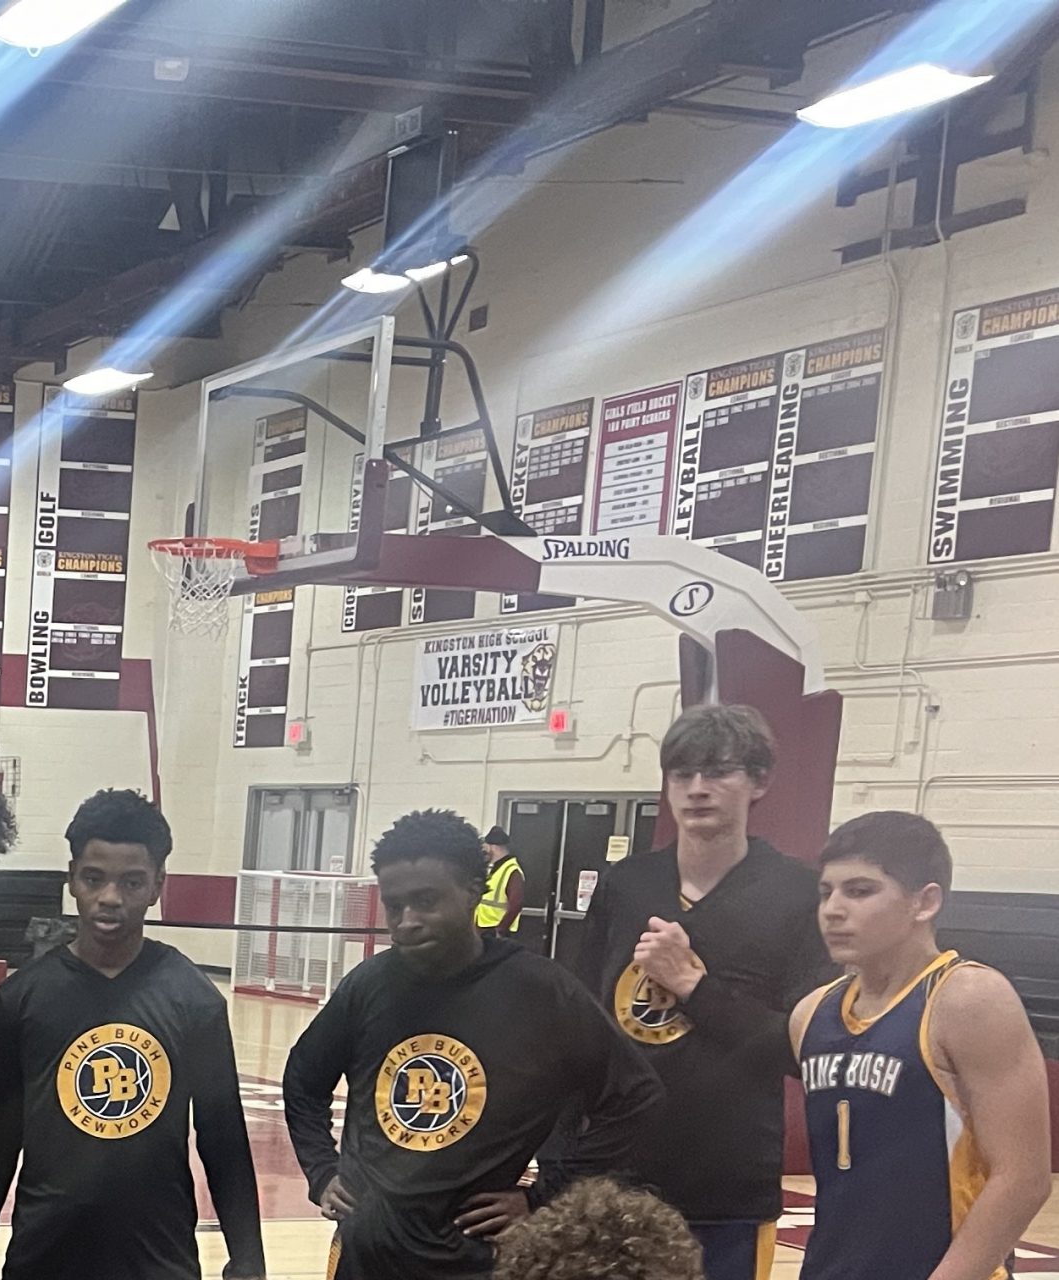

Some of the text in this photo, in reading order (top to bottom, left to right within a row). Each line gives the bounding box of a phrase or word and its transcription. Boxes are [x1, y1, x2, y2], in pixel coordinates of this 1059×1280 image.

[982, 303, 1059, 336] CHAMPION
[807, 344, 882, 374] CHAMPIONS
[709, 369, 775, 397] CHAMPIONS
[513, 443, 529, 518] OCKEY
[675, 415, 701, 540] LEYBALL
[766, 383, 800, 578] CHEERLEADING
[933, 377, 969, 558] SWIMMING
[37, 491, 56, 543] GOLF
[57, 558, 123, 572] CHAMPIONS
[542, 537, 630, 560] SPALDING
[30, 610, 50, 704] BOWLING
[424, 635, 476, 654] KINGSTON
[478, 632, 502, 649] HIGH
[437, 650, 518, 680] VARSITY
[235, 675, 248, 744] TRACK
[420, 676, 535, 707] VOLLEYBALL
[443, 705, 517, 727] #TIGERNATION
[64, 1028, 161, 1071] PINE BUSH
[384, 1040, 479, 1079] PINE BUSH
[845, 1052, 902, 1097] BUSH
[70, 1096, 161, 1133] NEW YORK
[382, 1112, 472, 1146] NEW YORK
[837, 1100, 851, 1170] 1
